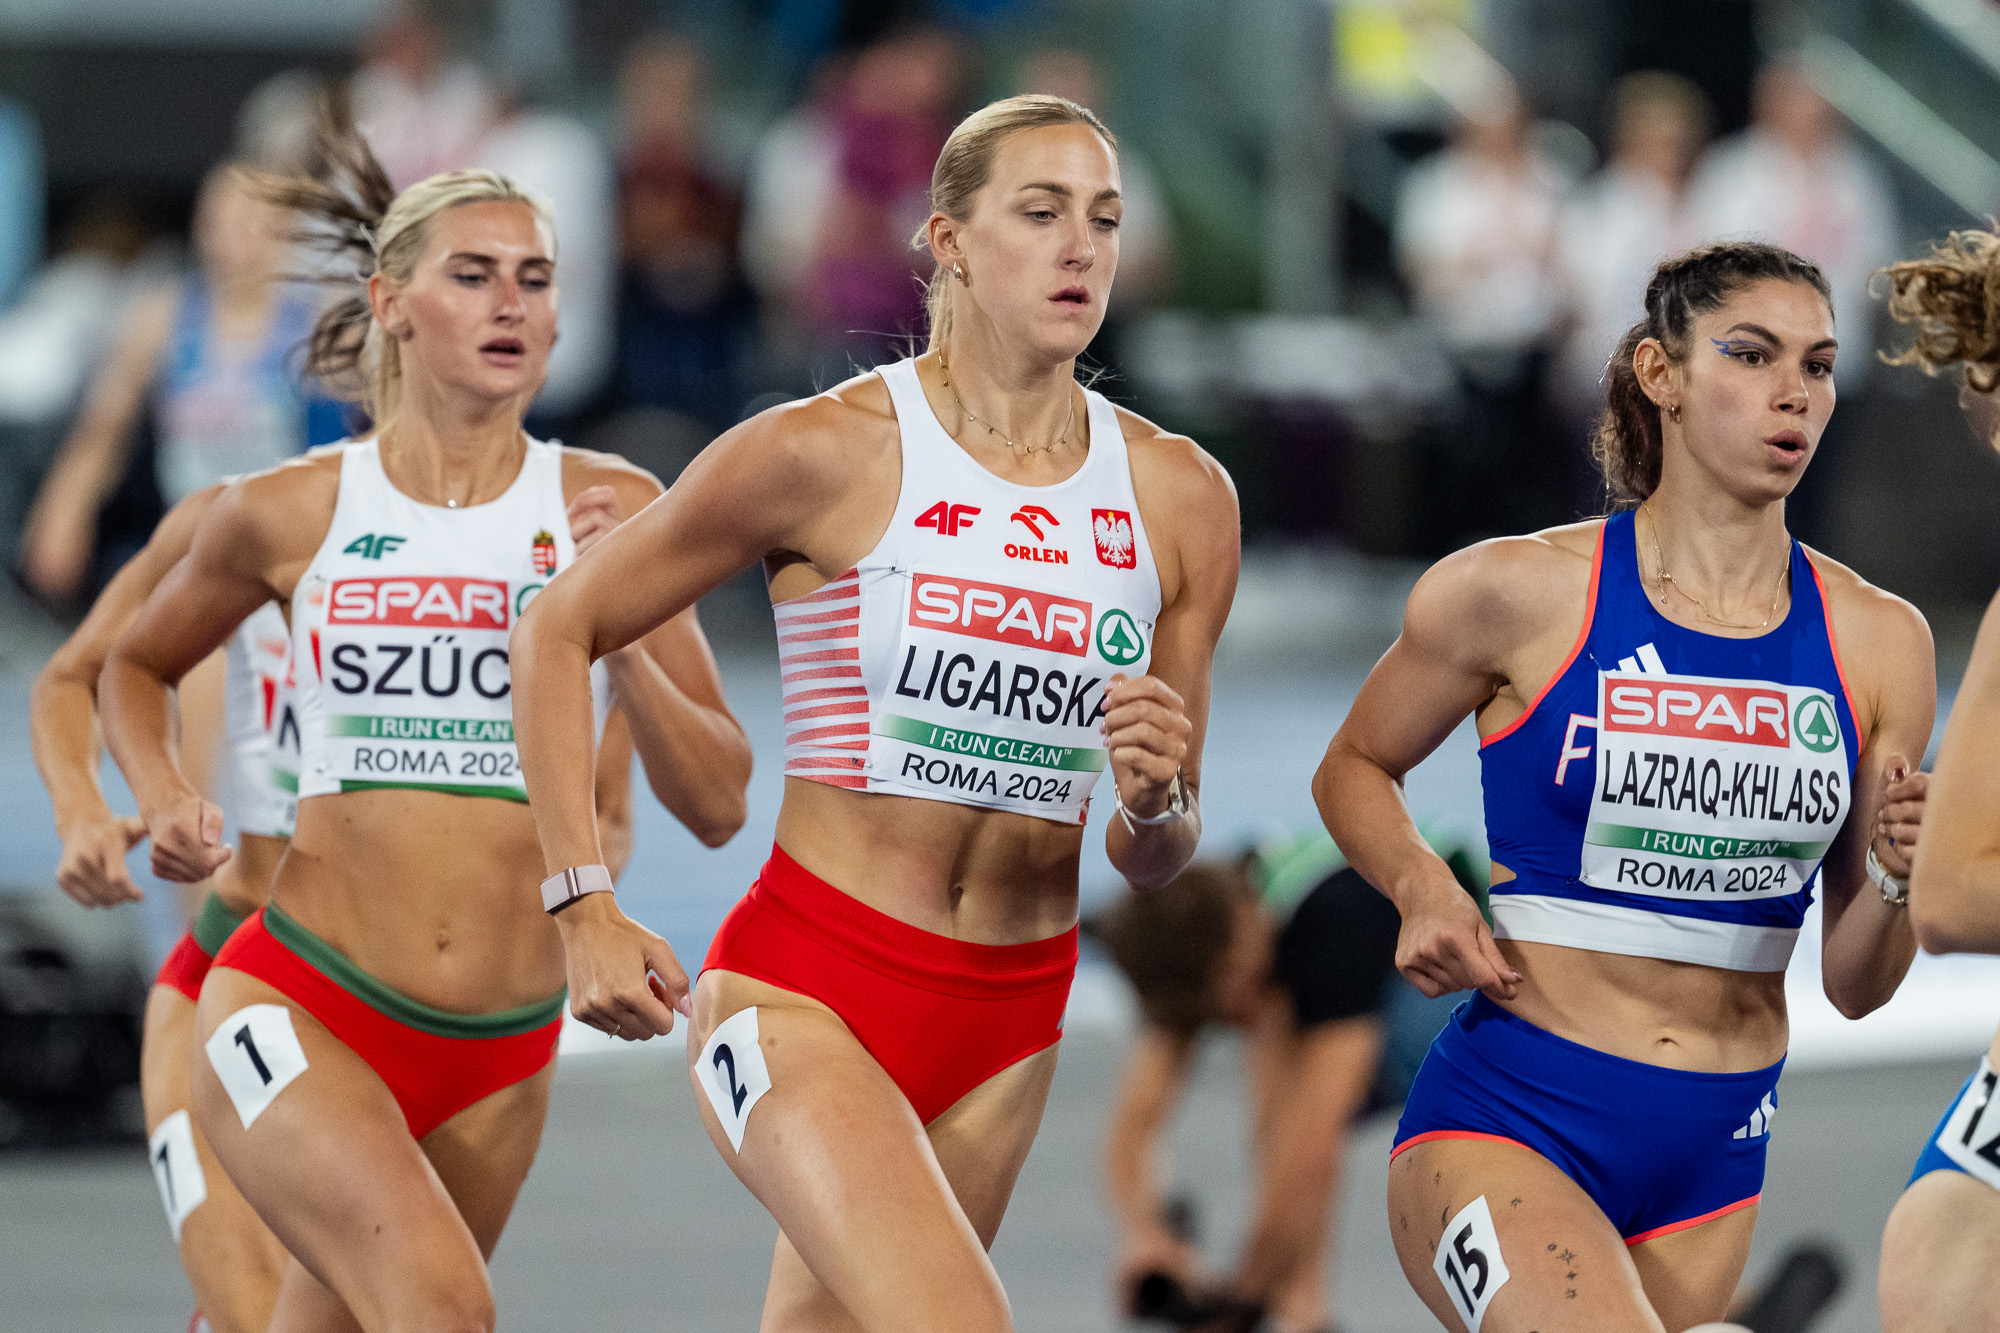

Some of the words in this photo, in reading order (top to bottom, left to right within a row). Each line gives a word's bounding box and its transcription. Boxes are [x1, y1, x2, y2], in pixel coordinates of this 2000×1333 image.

[914, 501, 982, 537] 4F
[342, 533, 408, 560] 4F
[1004, 543, 1069, 565] ORLEN
[331, 580, 507, 624] SPAR
[915, 581, 1087, 649] SPAR
[371, 718, 377, 735] I
[381, 718, 433, 739] RUN
[436, 721, 512, 741] CLEAN
[1610, 686, 1786, 740] SPAR
[354, 747, 450, 775] ROMA
[461, 751, 520, 777] 202
[929, 729, 938, 745] I
[942, 731, 992, 756] RUN
[901, 752, 997, 795] ROMA
[1005, 773, 1072, 803] 2024
[1601, 749, 1841, 826] LAZRAQ-KHLASS
[1641, 831, 1649, 848] I
[1653, 832, 1705, 856] RUN
[1617, 858, 1716, 893] ROMA
[1723, 864, 1787, 893] 2024
[234, 1023, 273, 1086] 1
[713, 1043, 748, 1119] 2
[1445, 1221, 1489, 1319] 15
